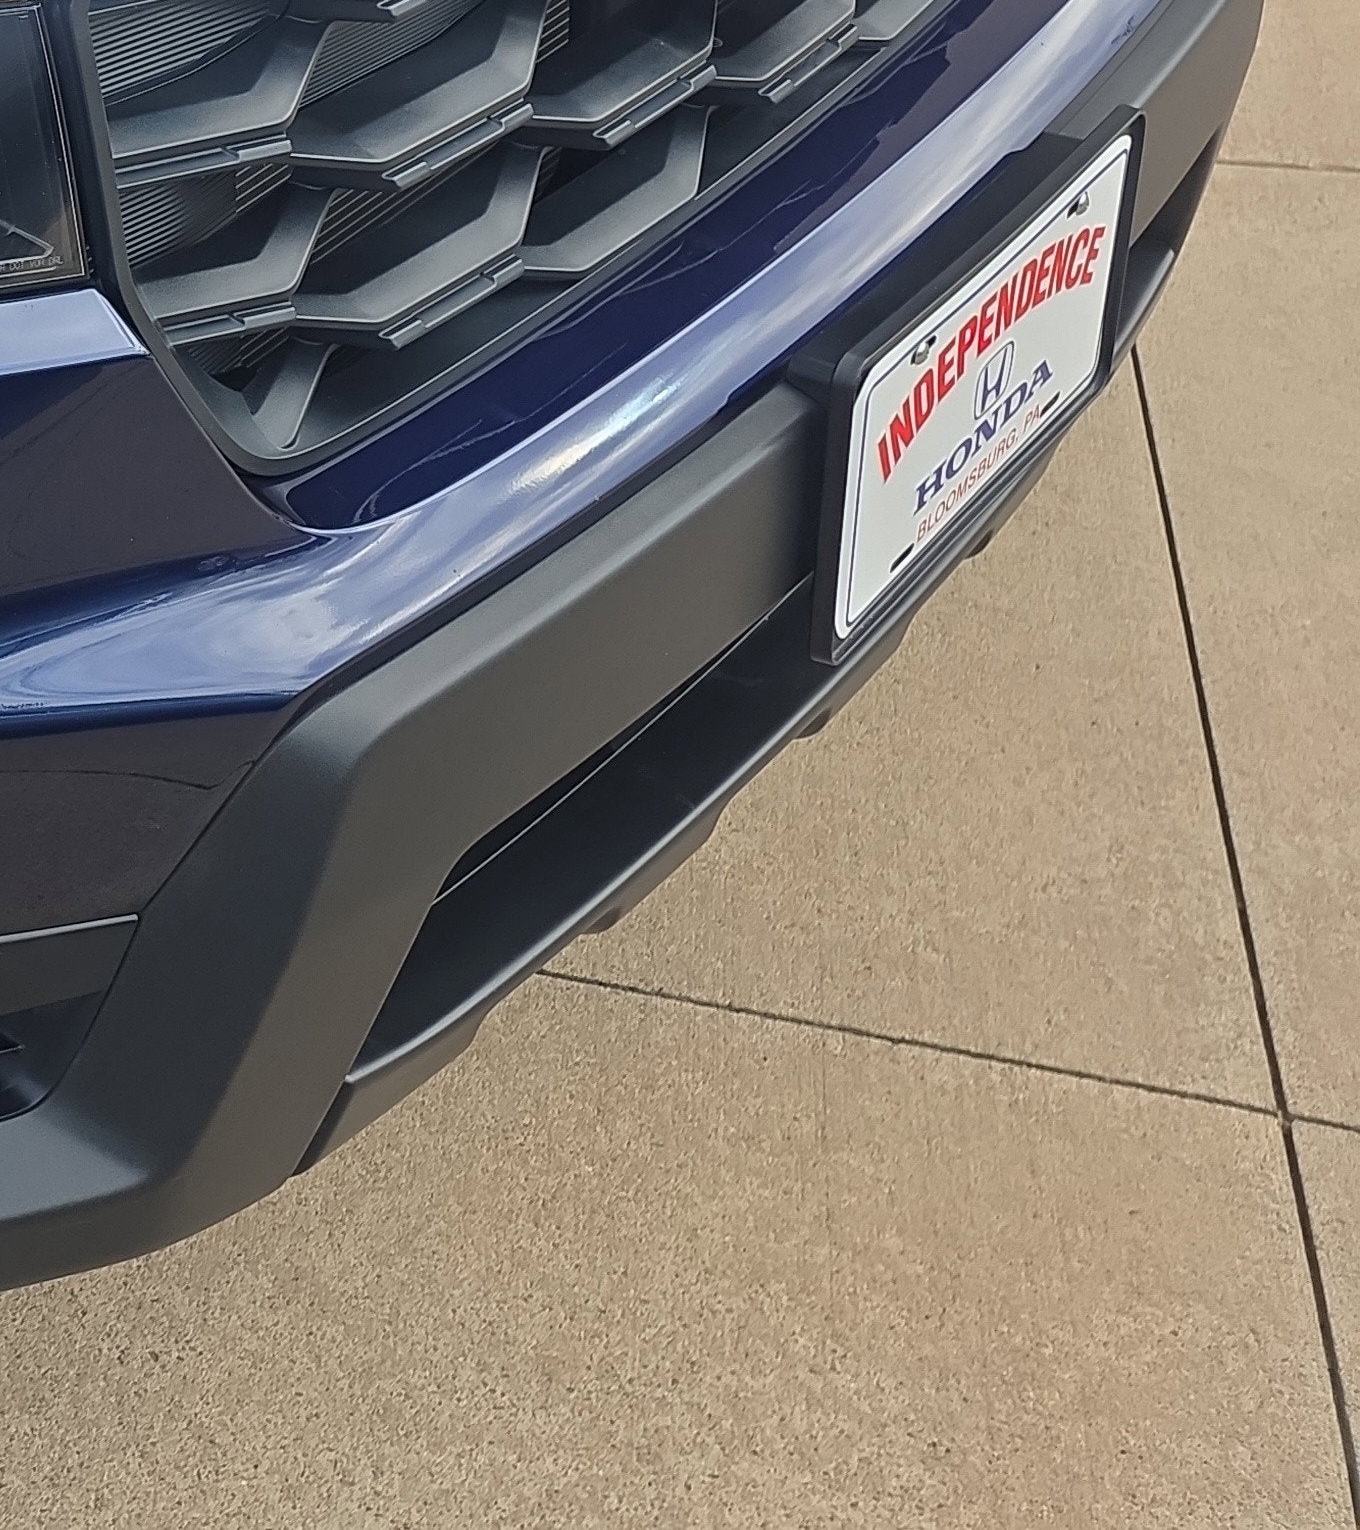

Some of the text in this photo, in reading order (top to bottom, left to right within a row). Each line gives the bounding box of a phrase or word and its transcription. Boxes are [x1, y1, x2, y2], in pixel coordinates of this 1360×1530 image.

[877, 225, 1106, 483] INDEPENDENCE
[913, 360, 1053, 516] HONDA
[917, 404, 1041, 542] BLOOMSBURG, PA
